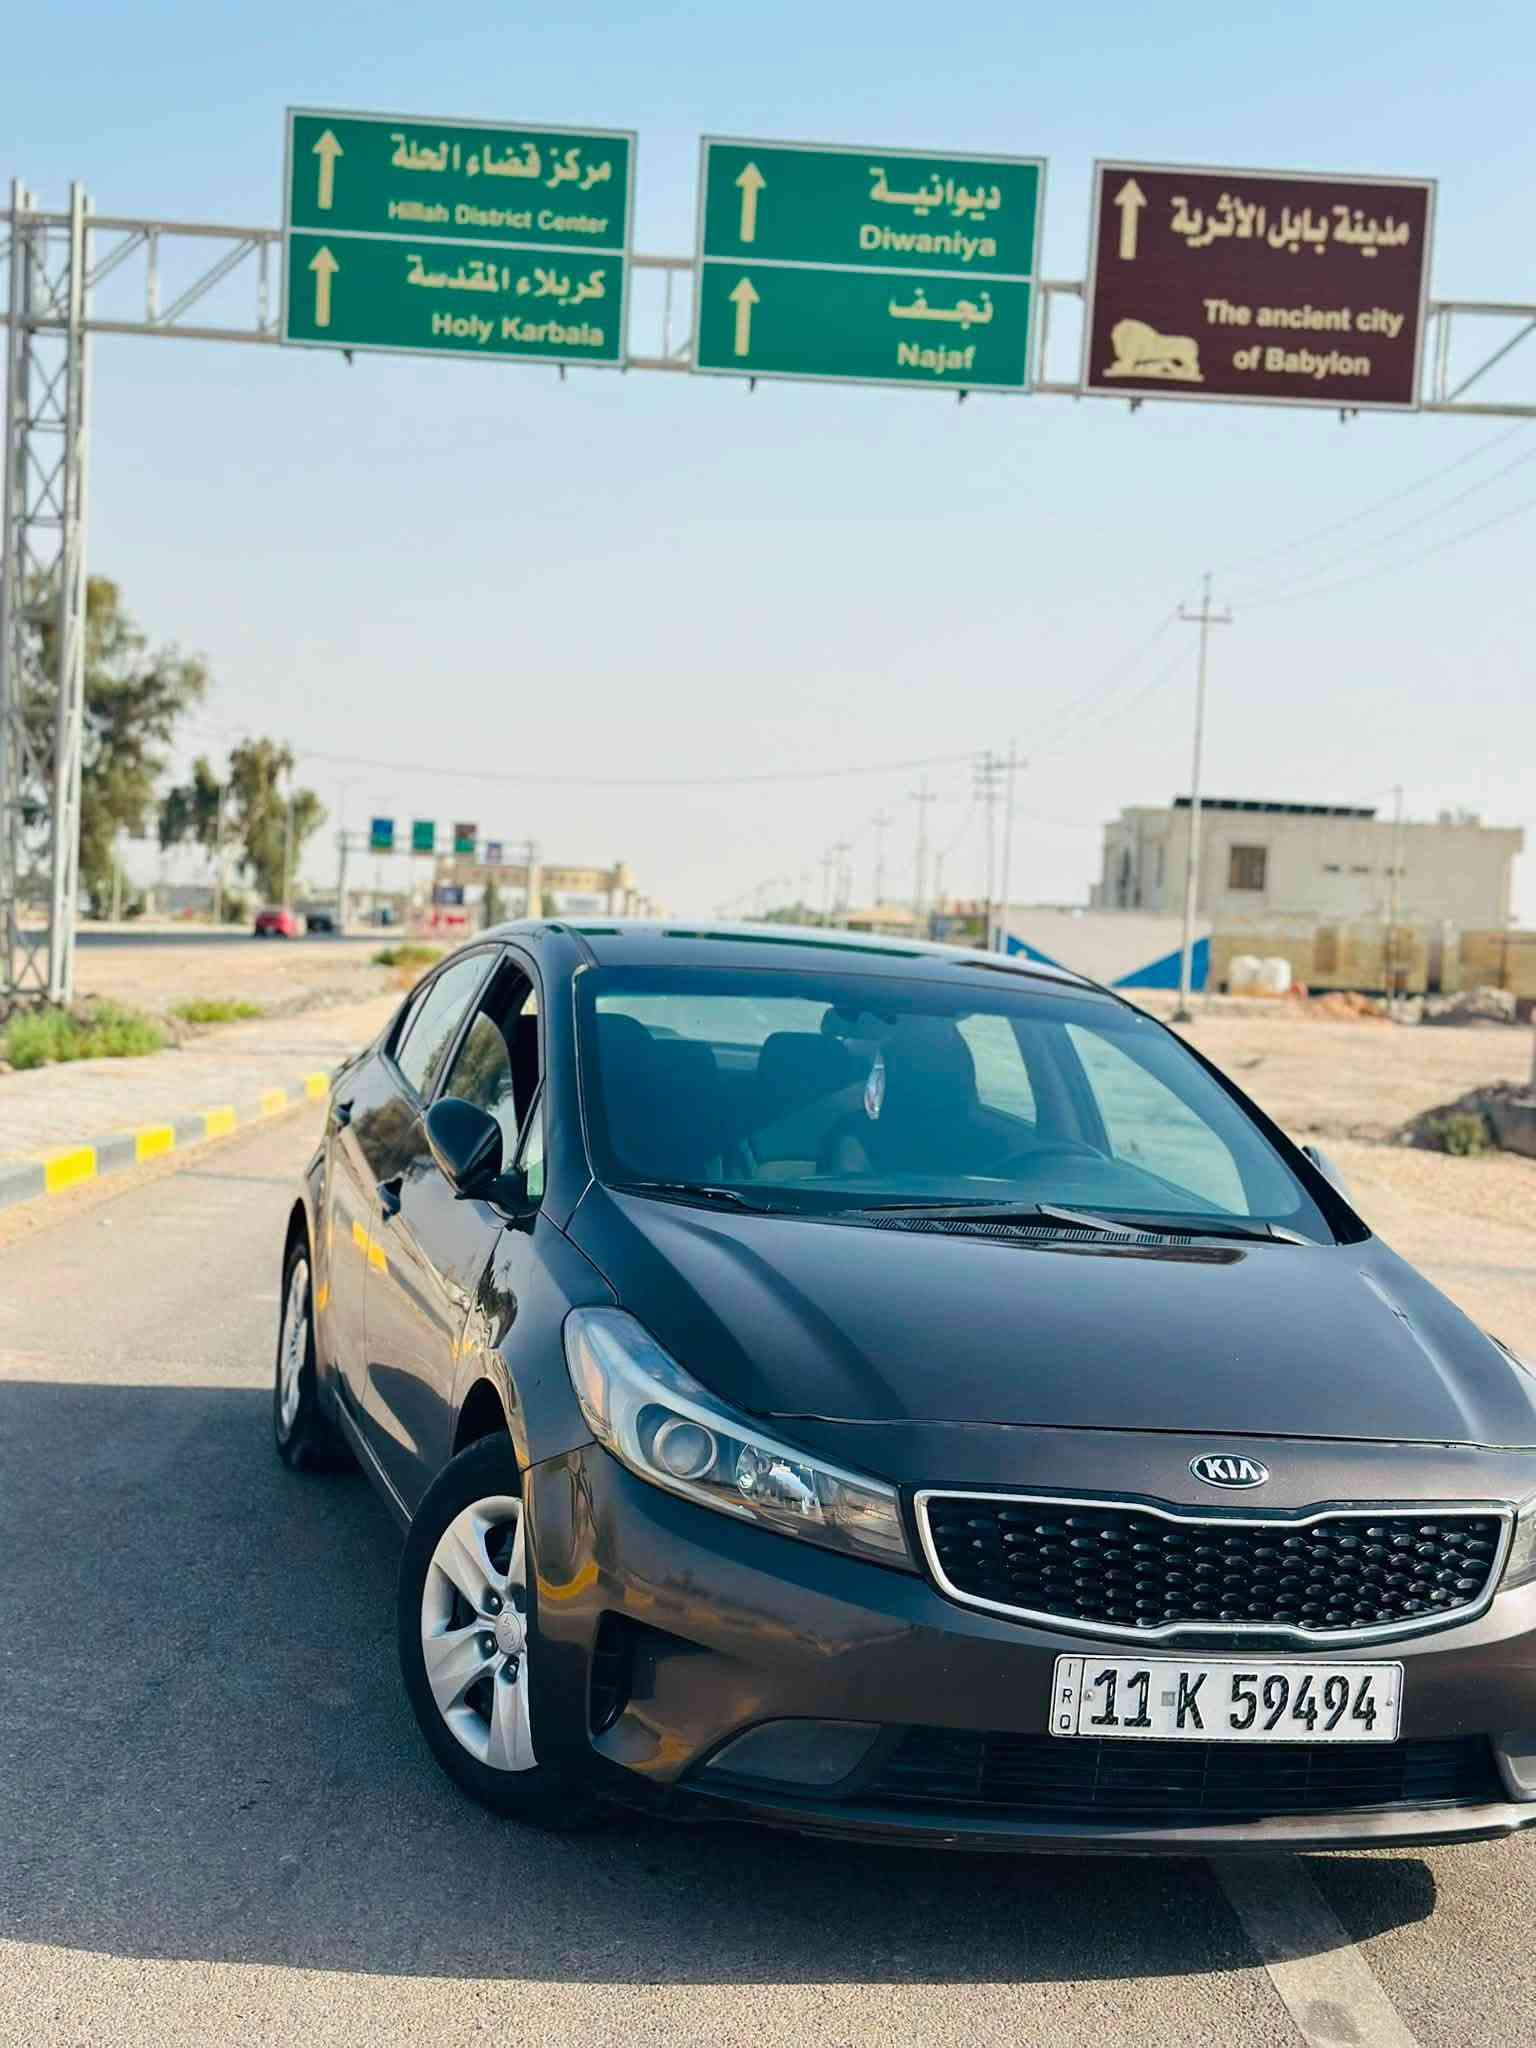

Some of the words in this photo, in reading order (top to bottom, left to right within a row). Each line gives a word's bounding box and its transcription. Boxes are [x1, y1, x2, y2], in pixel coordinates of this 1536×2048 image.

[390, 133, 460, 172] الحلة
[466, 143, 541, 178] قضاء
[546, 147, 612, 190] مركز
[869, 166, 1002, 220] ديوانية
[389, 200, 449, 222] Hillah
[455, 204, 532, 229] District
[538, 210, 609, 234] Center
[1170, 192, 1266, 248] الأثرية
[1267, 206, 1329, 254] بابل
[1332, 204, 1410, 257] مدينة
[859, 224, 997, 263] Diwaniya
[406, 254, 511, 293] المقدسة
[515, 268, 606, 306] كربلاء
[888, 287, 993, 329] نجف
[1204, 299, 1251, 325] The
[1257, 304, 1350, 332] ancient
[1356, 307, 1405, 338] city
[432, 312, 494, 343] Holy
[501, 317, 605, 347] Karbala
[897, 342, 976, 374] Najaf
[1233, 345, 1261, 371] of
[1264, 347, 1372, 380] Babylon
[1203, 1458, 1260, 1480] KIA
[1091, 1669, 1152, 1728] 11
[1176, 1672, 1208, 1729] K
[1230, 1674, 1378, 1731] 59494
